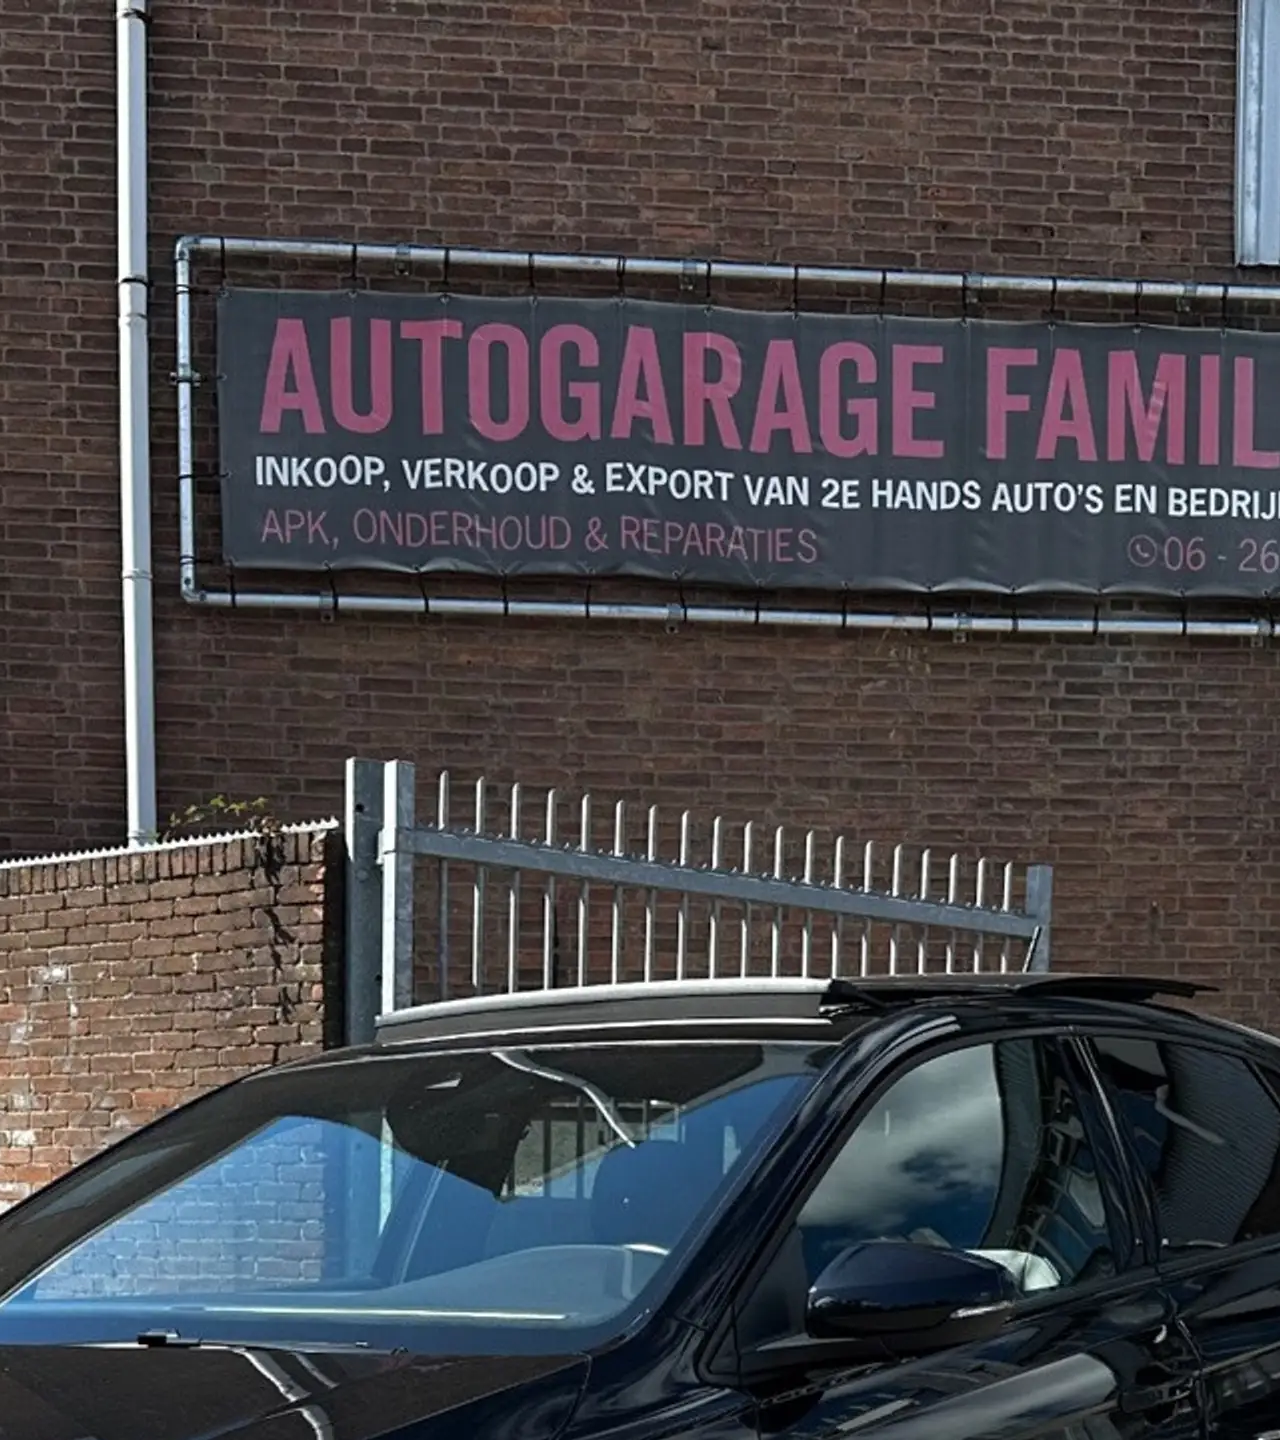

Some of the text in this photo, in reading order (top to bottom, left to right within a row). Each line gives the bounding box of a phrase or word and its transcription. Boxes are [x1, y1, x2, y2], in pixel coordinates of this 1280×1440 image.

[260, 316, 944, 458] AUTOGARAGE
[255, 454, 390, 493] INKOOP,
[401, 456, 560, 493] VERKOOP
[571, 463, 596, 494] &
[606, 462, 735, 502] EXPORT
[743, 474, 809, 507] VAN
[821, 478, 861, 509] 2E
[871, 478, 982, 511] HANDS
[991, 482, 1104, 515] AUTO'S
[1115, 483, 1157, 514] EN
[261, 508, 818, 564] APK, ONDERHOUD & REPARATIES
[1163, 534, 1206, 571] 06
[1238, 537, 1280, 573] 26
